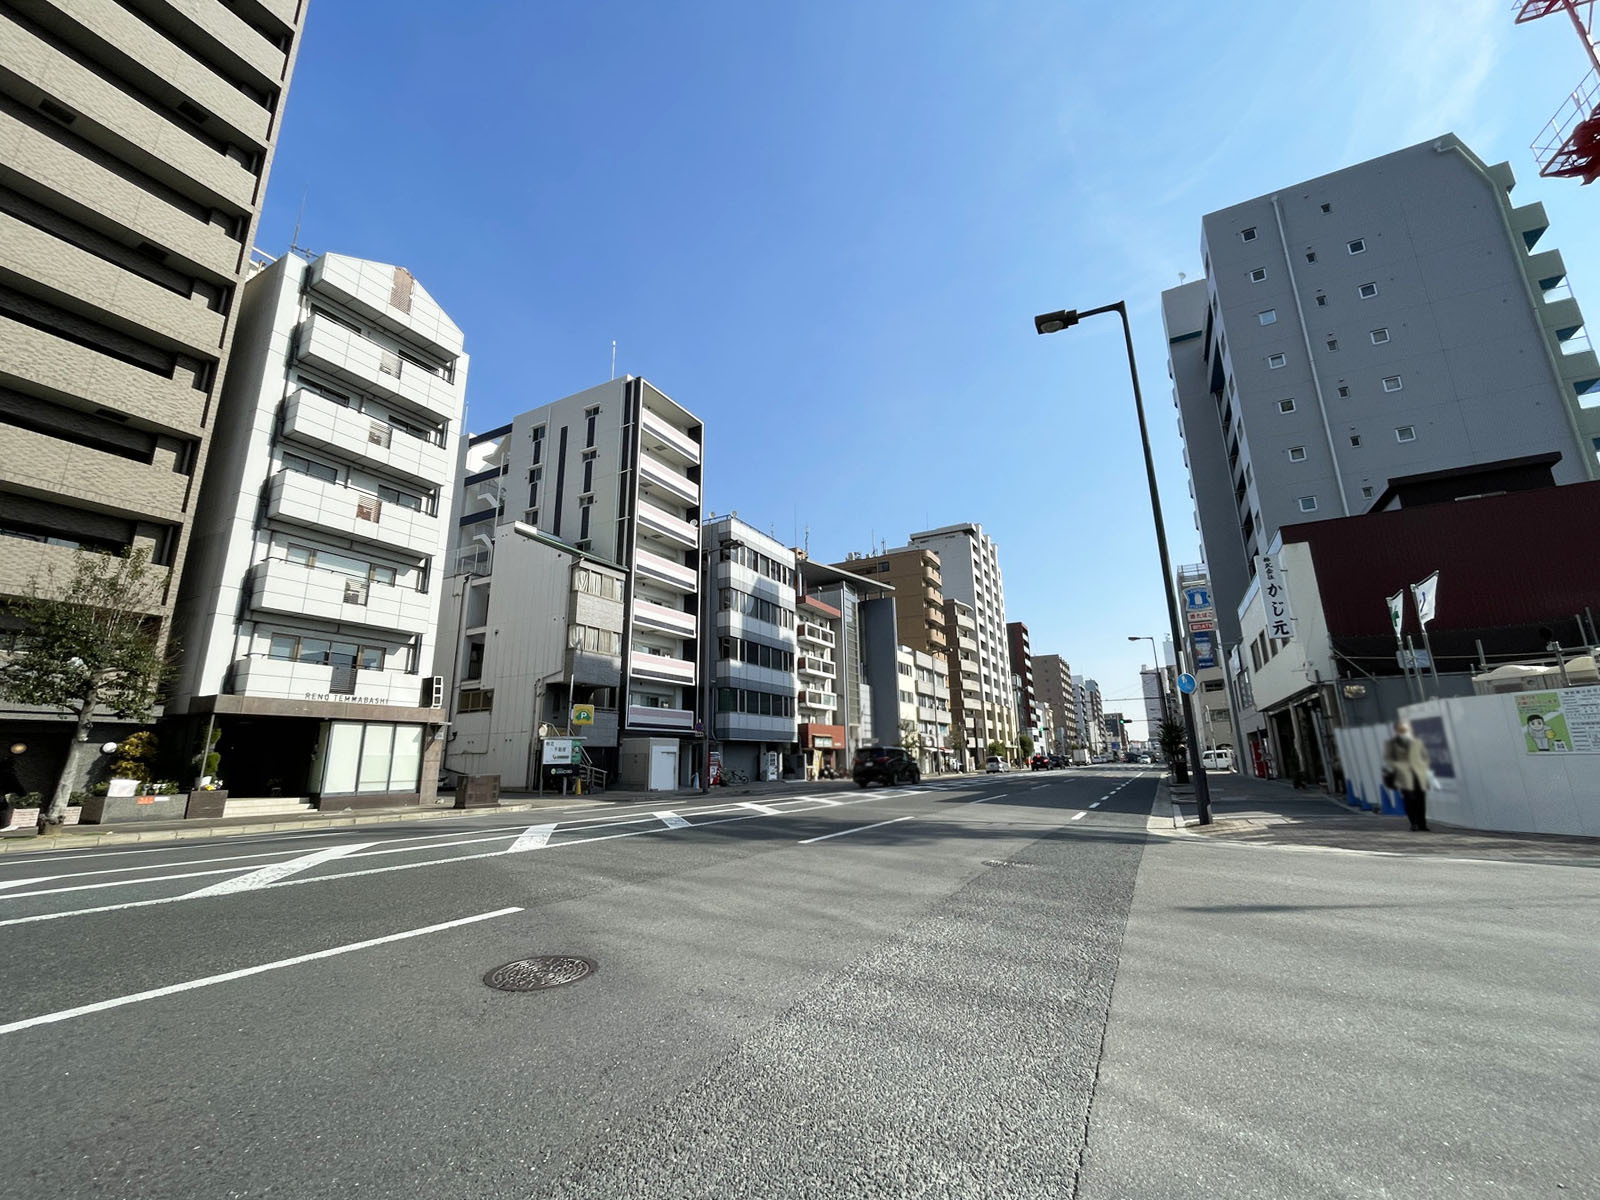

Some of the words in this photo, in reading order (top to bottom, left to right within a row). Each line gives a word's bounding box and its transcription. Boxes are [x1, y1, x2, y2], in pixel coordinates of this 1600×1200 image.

[1267, 583, 1290, 635] かじ元
[304, 692, 329, 701] RENO
[334, 694, 389, 704] TEMMABASHI
